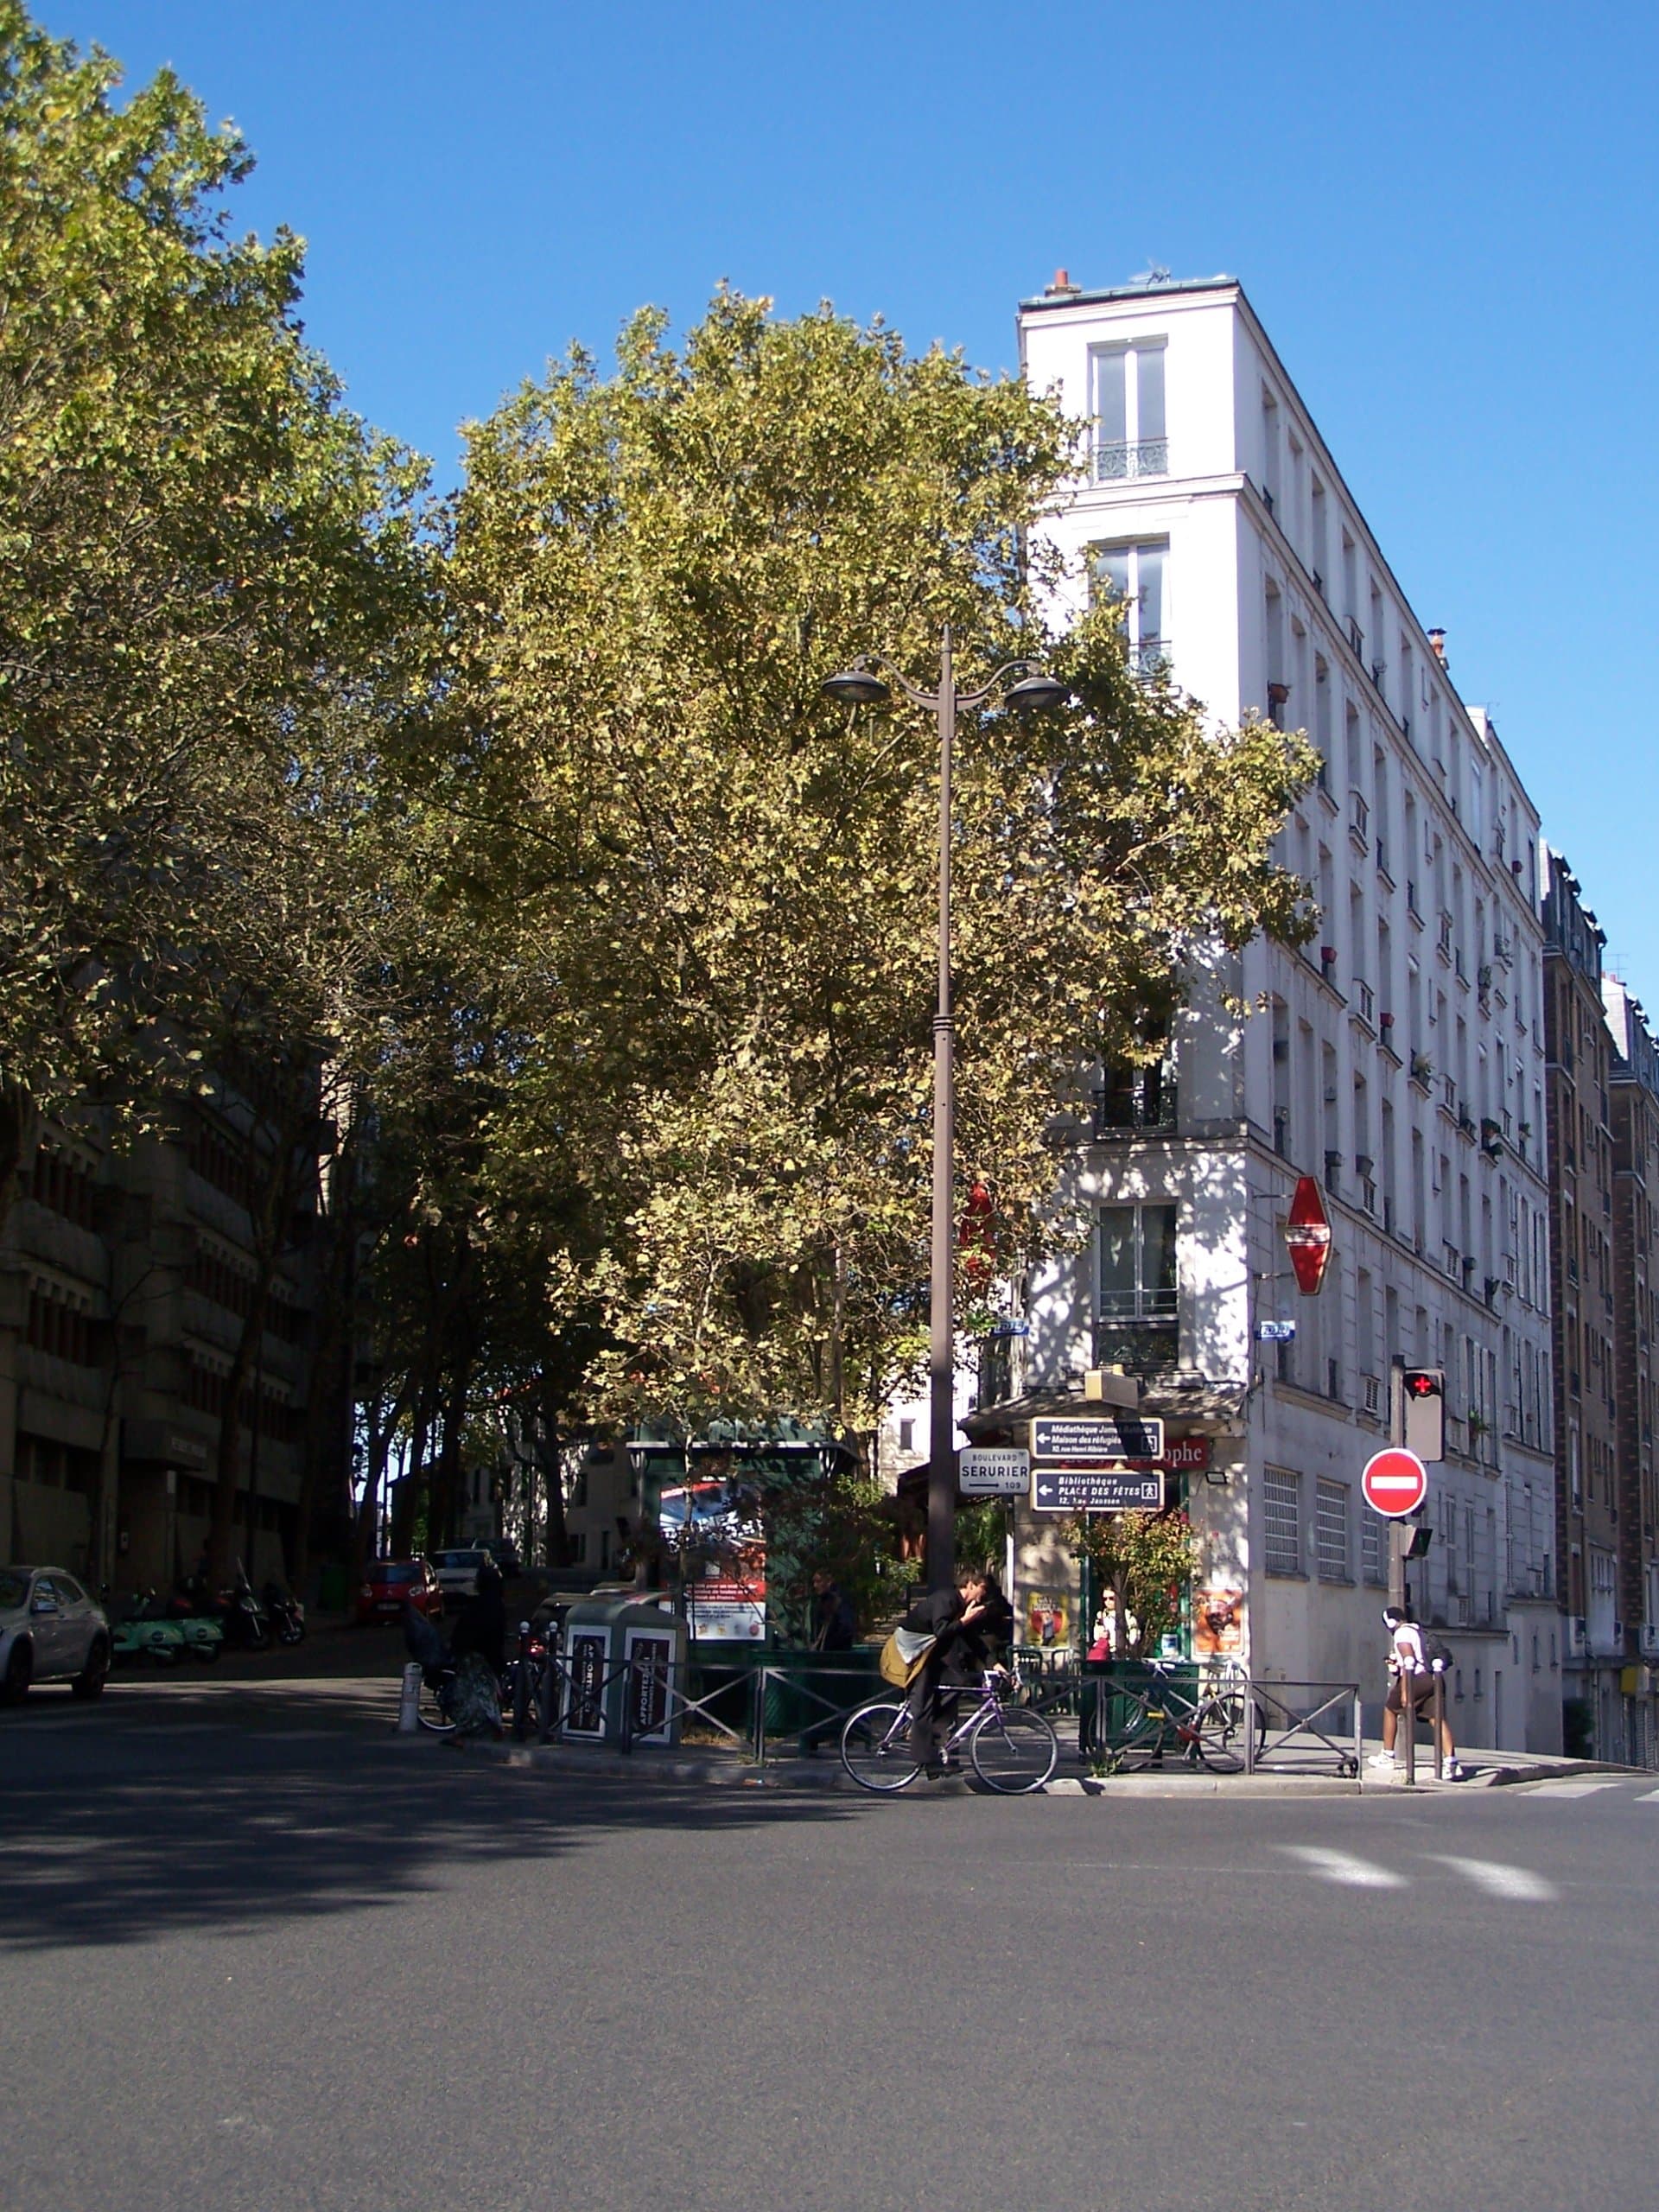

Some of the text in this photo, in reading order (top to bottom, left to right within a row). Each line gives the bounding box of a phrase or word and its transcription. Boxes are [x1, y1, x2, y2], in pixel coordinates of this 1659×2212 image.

[1051, 1424, 1098, 1435] Médiathèque
[1051, 1435, 1122, 1446] Maison des réfugiés
[972, 1453, 1018, 1462] BOULEVARD
[962, 1465, 1028, 1477] SERURIER
[1005, 1481, 1021, 1490] 109
[1058, 1476, 1117, 1486] Bibliothèque
[1058, 1485, 1141, 1496] PLACE DES FÊTES
[1090, 1497, 1121, 1505] Janssen
[584, 1643, 595, 1694] APORTEZ
[639, 1673, 650, 1726] APPORTEZ
